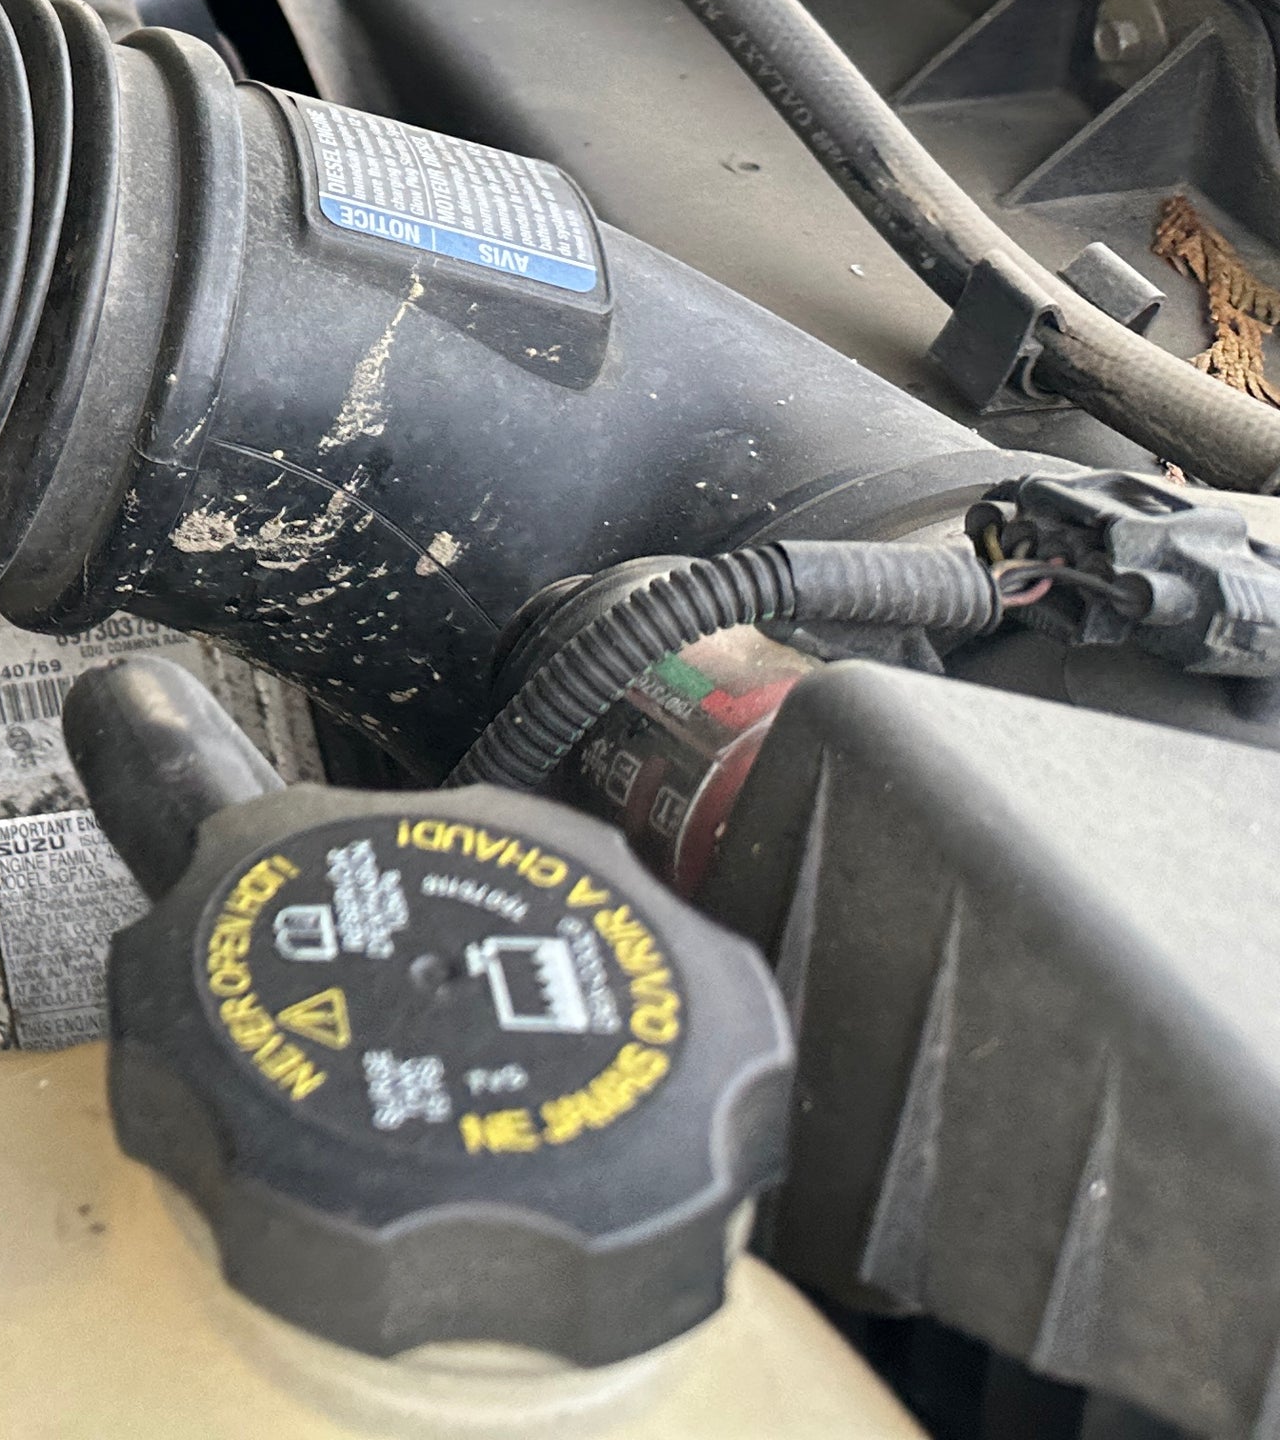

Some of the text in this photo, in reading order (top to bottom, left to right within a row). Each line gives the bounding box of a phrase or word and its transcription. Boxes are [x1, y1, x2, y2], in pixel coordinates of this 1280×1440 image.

[322, 149, 347, 194] DIESEL
[410, 190, 424, 216] Glow
[427, 168, 455, 224] MOTEUR
[340, 205, 420, 244] NOTICE
[478, 243, 529, 273] AVIS
[557, 242, 572, 256] du
[49, 848, 98, 872] FAMILY
[218, 992, 328, 1102] NEVER
